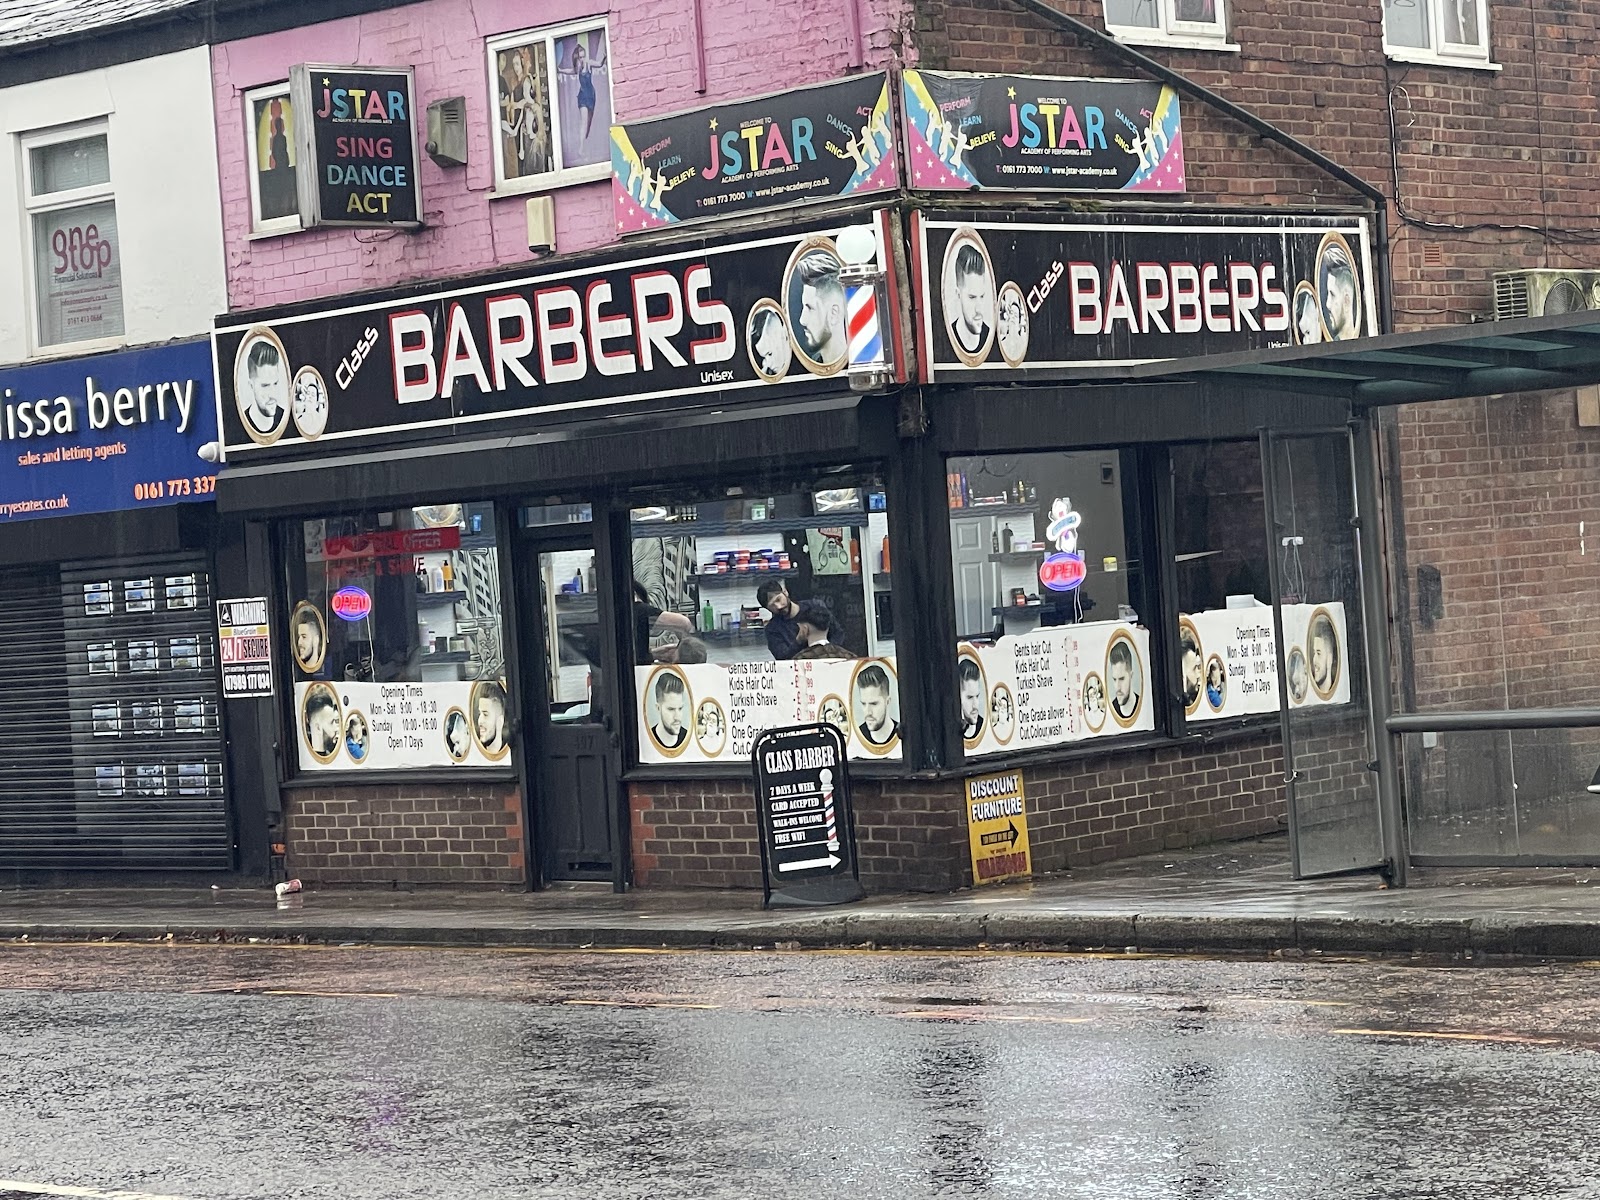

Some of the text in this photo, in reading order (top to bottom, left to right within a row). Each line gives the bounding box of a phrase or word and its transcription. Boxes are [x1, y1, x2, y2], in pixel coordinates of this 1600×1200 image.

[940, 96, 971, 113] PERFORM
[1037, 97, 1060, 105] WELCOME
[856, 106, 873, 117] ACT
[1140, 107, 1154, 119] ACT
[740, 118, 764, 128] WELCOME
[826, 113, 852, 135] DANCE
[959, 114, 982, 127] LEARN
[1115, 108, 1138, 134] DANCE
[336, 137, 393, 158] SING
[641, 137, 671, 158] PERFORM
[970, 131, 996, 148] BELIEVE
[1114, 133, 1130, 151] SING
[825, 140, 843, 158] SING
[1021, 147, 1092, 157] ACADEMY OF PERFORMING ARTS
[658, 155, 681, 169] LEARN
[1002, 164, 1015, 175] 0161
[1015, 165, 1027, 175] 773
[1027, 165, 1043, 175] 7000
[1051, 165, 1118, 177] www.jstar-academy.co.uk
[327, 165, 407, 186] DANCE
[669, 167, 696, 188] BELIEVE
[722, 164, 799, 184] ACADEMY OF PERFORMING ARTS
[703, 196, 717, 206] 0161
[717, 195, 729, 204] 773
[729, 193, 746, 202] 7000
[755, 177, 830, 197] www.jstar-academy.co.uk
[347, 193, 392, 213] ACT
[1026, 260, 1290, 335] Class BARBERS
[335, 264, 736, 405] Class BARBERS
[700, 369, 735, 384] Unisex
[0, 377, 193, 440] issa berry
[18, 442, 127, 466] sales and letting agents
[134, 482, 163, 501] 0161
[167, 478, 190, 497] 773
[1042, 562, 1083, 582] OPEN
[332, 594, 371, 613] OPEN
[231, 602, 266, 625] WARNING
[1236, 625, 1270, 643] Opening Times
[243, 638, 269, 660] SECURE
[1014, 640, 1052, 657] Gents hair Cut
[1227, 645, 1237, 659] Mon
[1241, 644, 1249, 658] Sat
[728, 662, 748, 675] Gents
[749, 661, 763, 674] hair
[764, 660, 777, 673] Cut
[1015, 657, 1050, 674] Kids Hair Cut
[1228, 663, 1246, 679] Sunday
[728, 677, 774, 691] Kids Hair Cut
[1016, 673, 1053, 690] Turkish Shave
[1242, 680, 1254, 696] Open
[1259, 679, 1271, 695] Days
[381, 684, 423, 701] Opening Times
[729, 693, 754, 707] Turkish
[756, 693, 777, 706] Shave
[1017, 693, 1030, 706] OAP
[369, 702, 382, 715] Mon
[386, 702, 396, 715] Sat
[400, 701, 412, 714] 9:00
[730, 710, 746, 723] OAP
[1018, 710, 1029, 724] One
[1030, 708, 1046, 722] Grade
[371, 719, 393, 735] Sunday
[402, 718, 418, 731] 10:00
[731, 725, 745, 739] One
[387, 735, 403, 751] Open
[409, 735, 424, 751] Days
[765, 745, 836, 775] CLASS BARBER
[769, 782, 815, 796] 7 DAYS A WEEK
[970, 775, 1019, 799] DISCOUNT
[771, 798, 819, 812] CARD ACCEPTED
[971, 797, 1022, 822] FURNITURE
[773, 814, 823, 829] WALK-INS WELCOME
[775, 831, 806, 844] FREE WIFI
